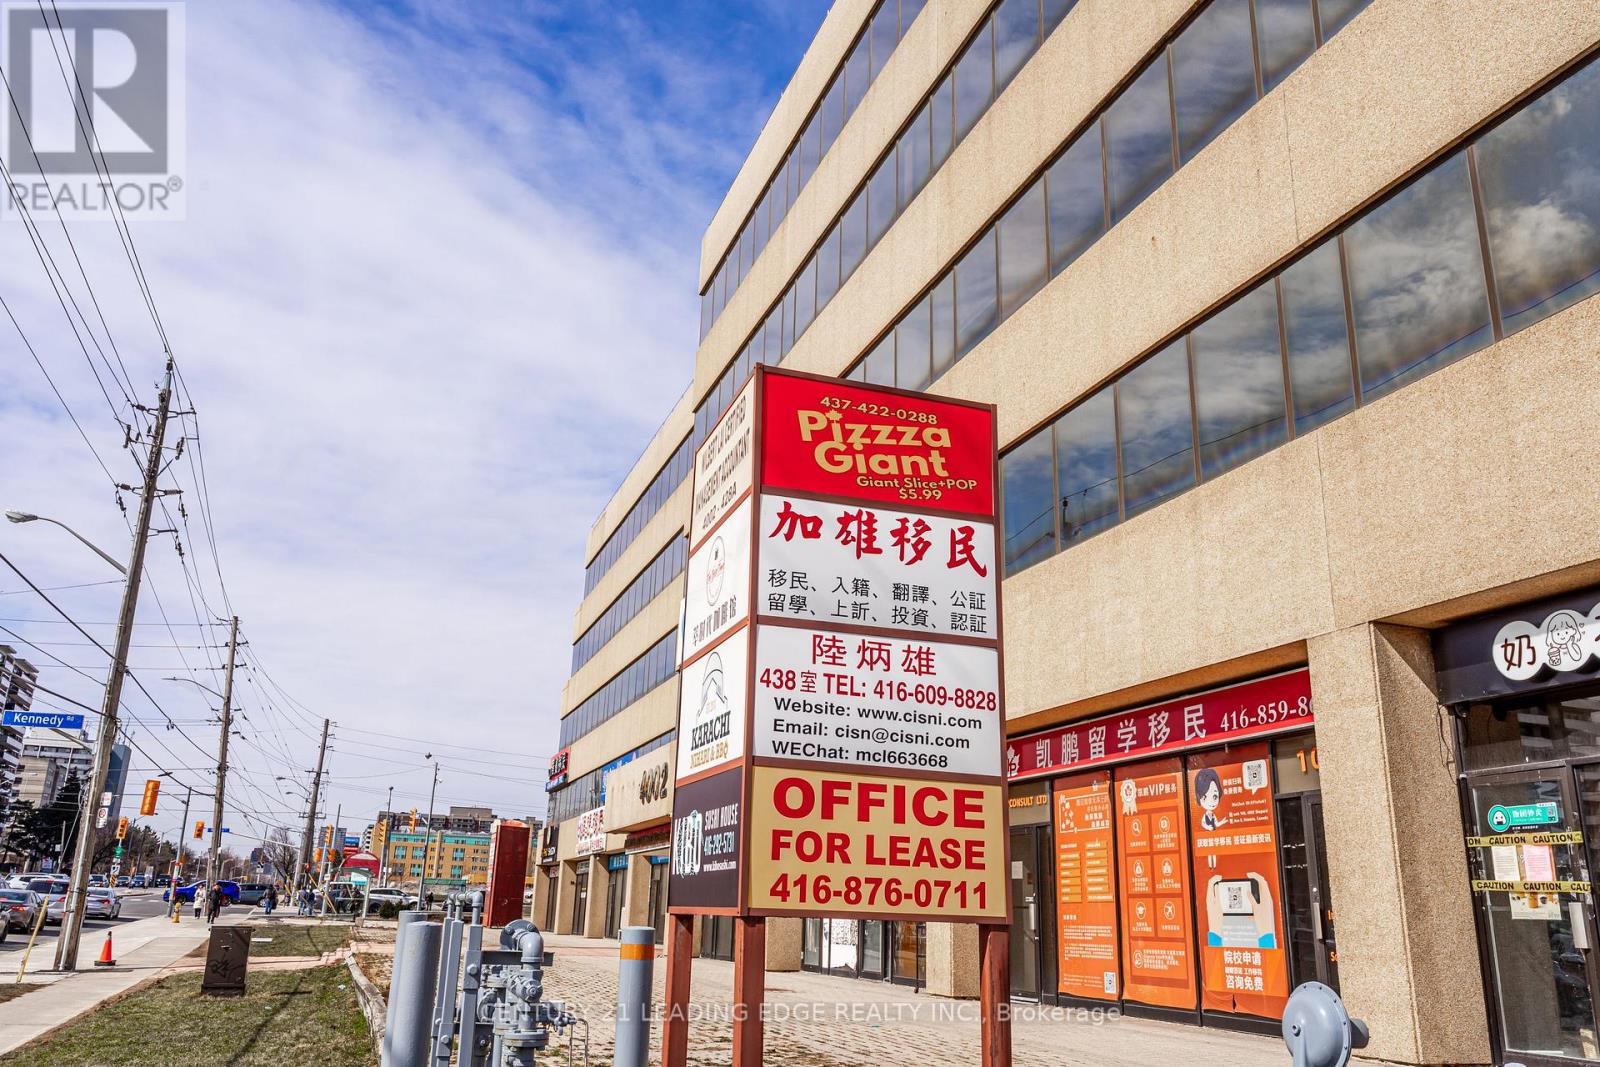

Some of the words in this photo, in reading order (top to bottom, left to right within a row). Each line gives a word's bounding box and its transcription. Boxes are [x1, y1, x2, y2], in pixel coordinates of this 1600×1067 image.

[797, 409, 951, 447] Pizzza
[820, 397, 937, 425] 437-422-0288
[814, 440, 949, 477] Giant
[856, 476, 900, 489] Giant
[899, 488, 942, 500] $5.99
[769, 501, 988, 577] 加雄移民
[812, 634, 936, 676] 陸炳雄
[1501, 634, 1536, 671] 奶
[823, 673, 866, 697] TEL:
[874, 680, 997, 711] 416-609-8828
[14, 713, 64, 727] Kennedy
[691, 710, 731, 751] KARACHI
[774, 697, 851, 717] Website:
[858, 707, 982, 729] www.cisni.com
[772, 741, 849, 759] WEChat:
[773, 719, 828, 737] Email:
[835, 725, 970, 749] cisn@cisni.com
[1036, 704, 1207, 768] 凯鹏留学移民
[639, 762, 668, 805] 4002
[1037, 794, 1047, 805] LTD
[705, 807, 720, 831] SUSHI
[720, 803, 738, 827] HOUSE
[773, 777, 985, 829] OFFICE
[771, 829, 851, 864] FOR
[866, 835, 986, 870] LEASE
[1489, 836, 1526, 845] CAUTION
[1533, 834, 1573, 844] CAUTION
[770, 873, 986, 909] 416-876-0711
[1477, 882, 1514, 890] CAUTION
[1524, 882, 1562, 891] CAUTION
